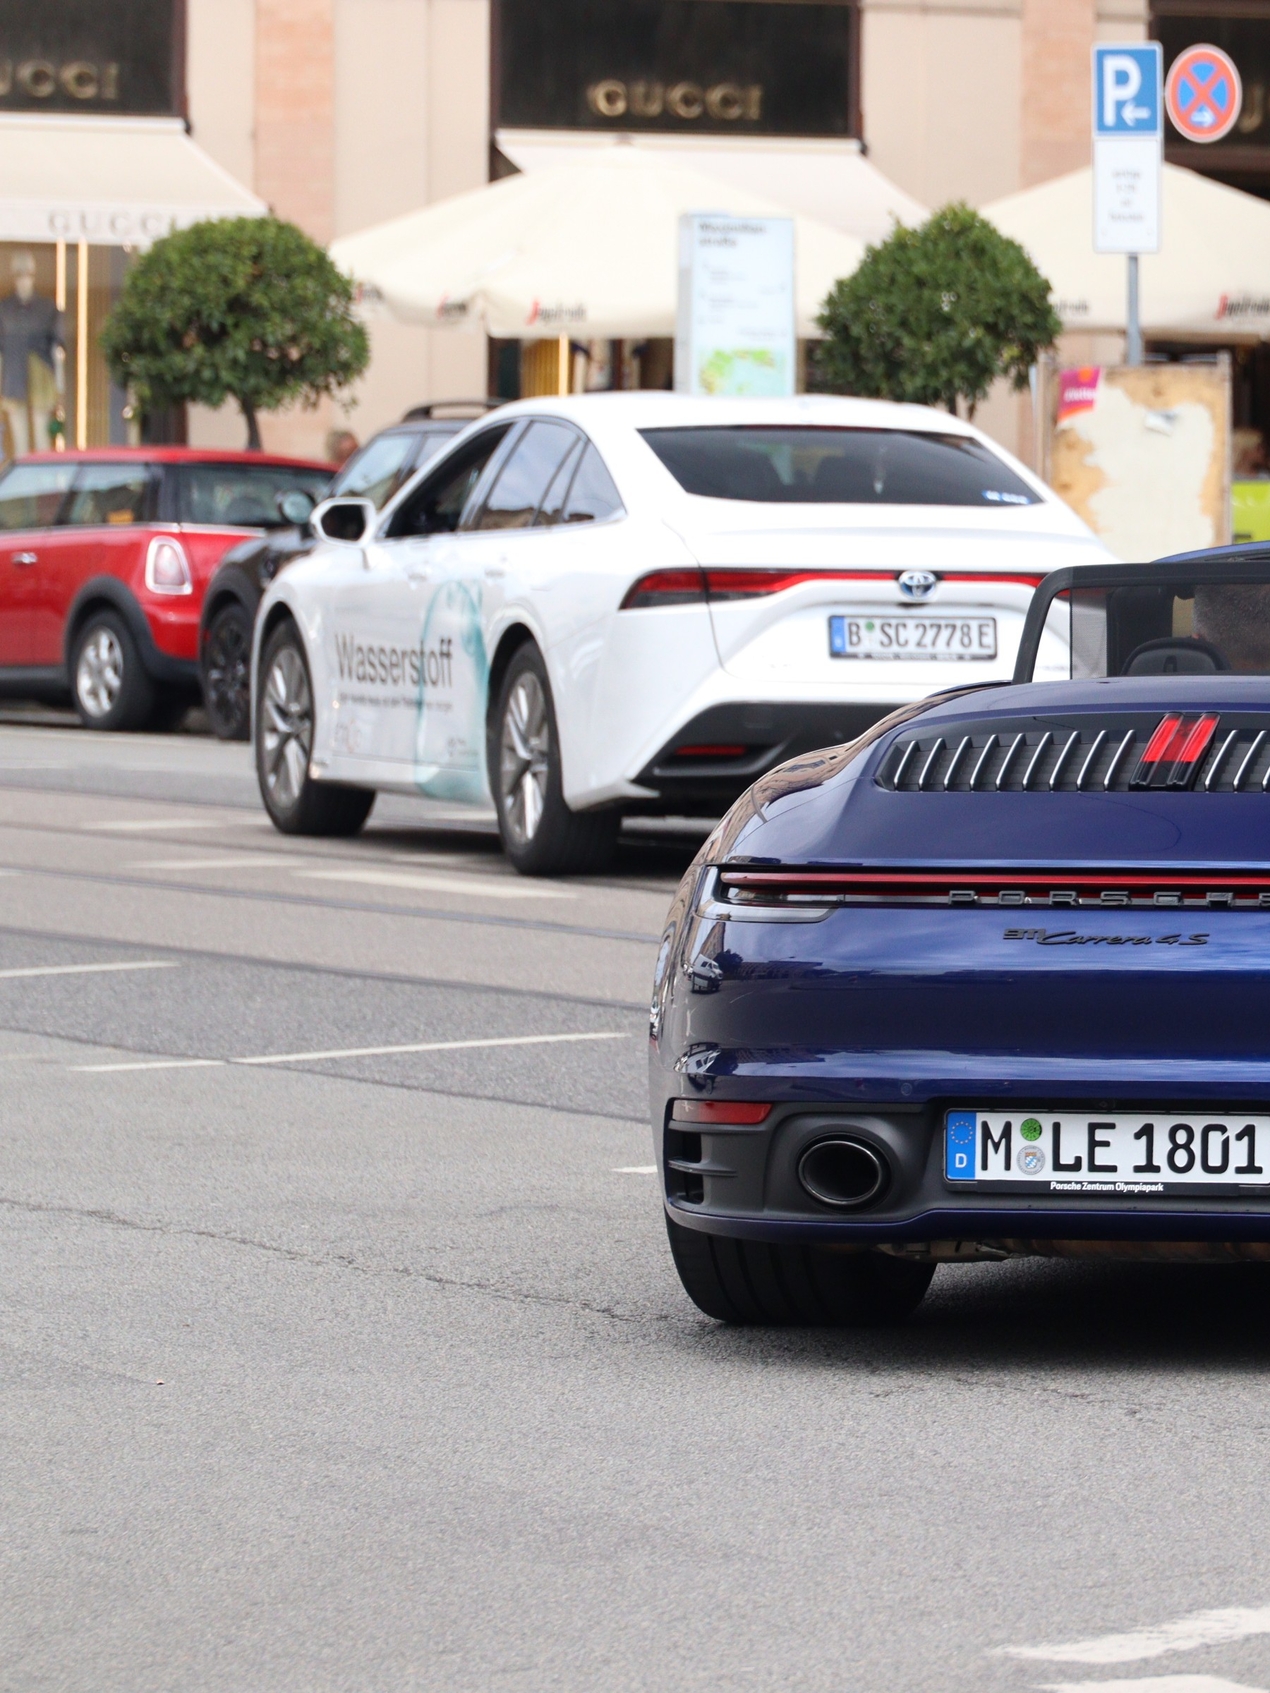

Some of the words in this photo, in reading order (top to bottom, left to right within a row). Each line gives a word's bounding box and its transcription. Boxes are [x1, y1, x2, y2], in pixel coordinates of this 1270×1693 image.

[587, 79, 763, 120] GUCCI
[1103, 55, 1142, 127] P
[849, 621, 861, 646] B
[880, 622, 908, 648] SC
[335, 634, 453, 688] Wasserstoff
[1037, 931, 1152, 946] Carrera
[955, 1153, 967, 1168] D
[981, 1120, 1012, 1172] M
[1052, 1121, 1118, 1173] LE
[1133, 1123, 1263, 1175] 1801
[1050, 1181, 1081, 1191] Porsche
[1082, 1182, 1115, 1191] Zentrum
[1115, 1182, 1164, 1193] Olympiapark
